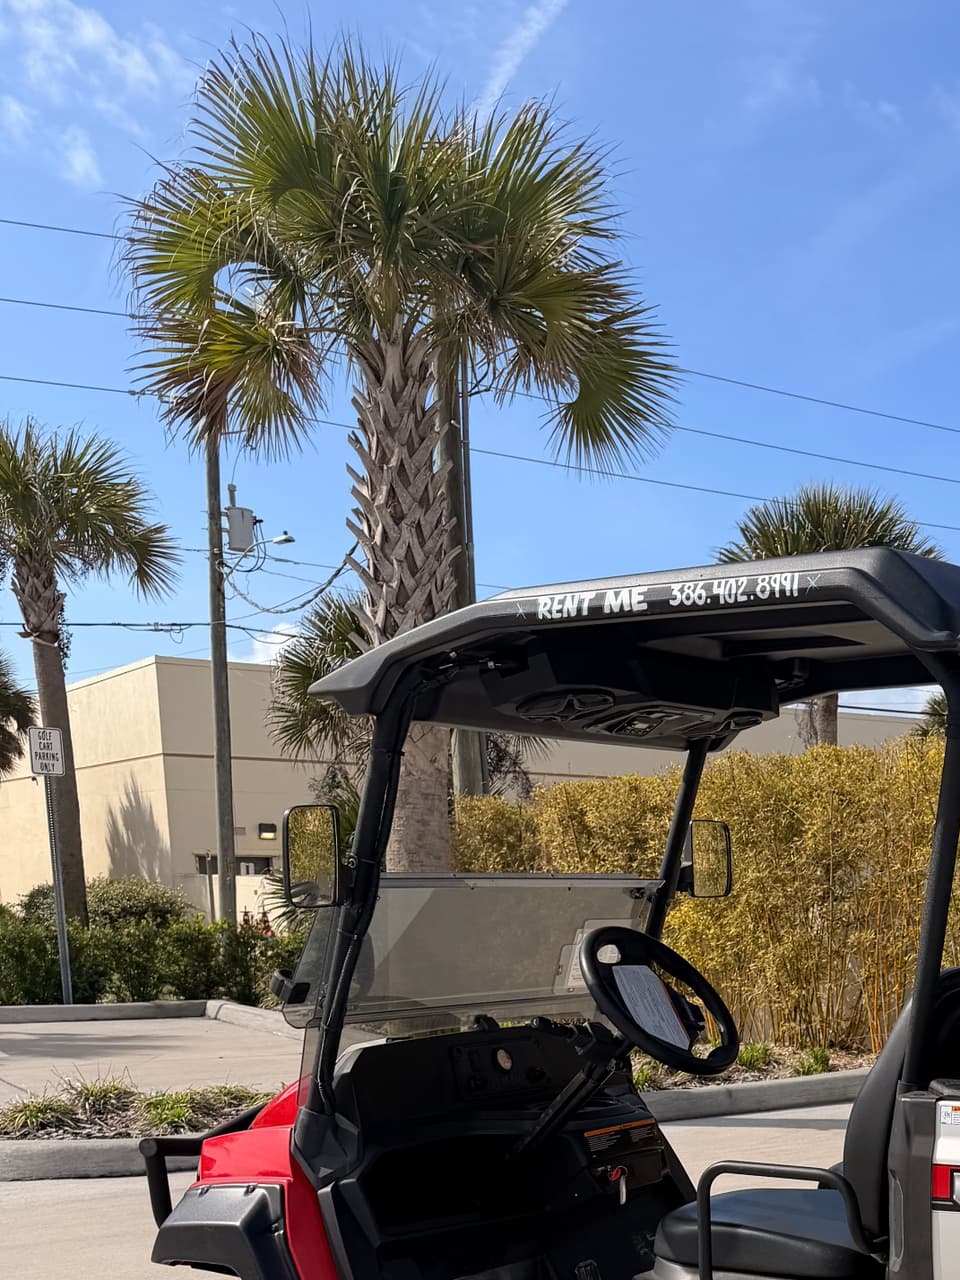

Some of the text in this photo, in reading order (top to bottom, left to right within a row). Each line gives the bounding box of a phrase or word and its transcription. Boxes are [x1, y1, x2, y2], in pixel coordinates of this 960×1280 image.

[537, 573, 800, 620] RENT ME 386.402.8991
[38, 730, 52, 741] GOLF
[39, 741, 53, 751] CART
[34, 752, 59, 762] PARKING
[40, 762, 55, 772] ONLY
